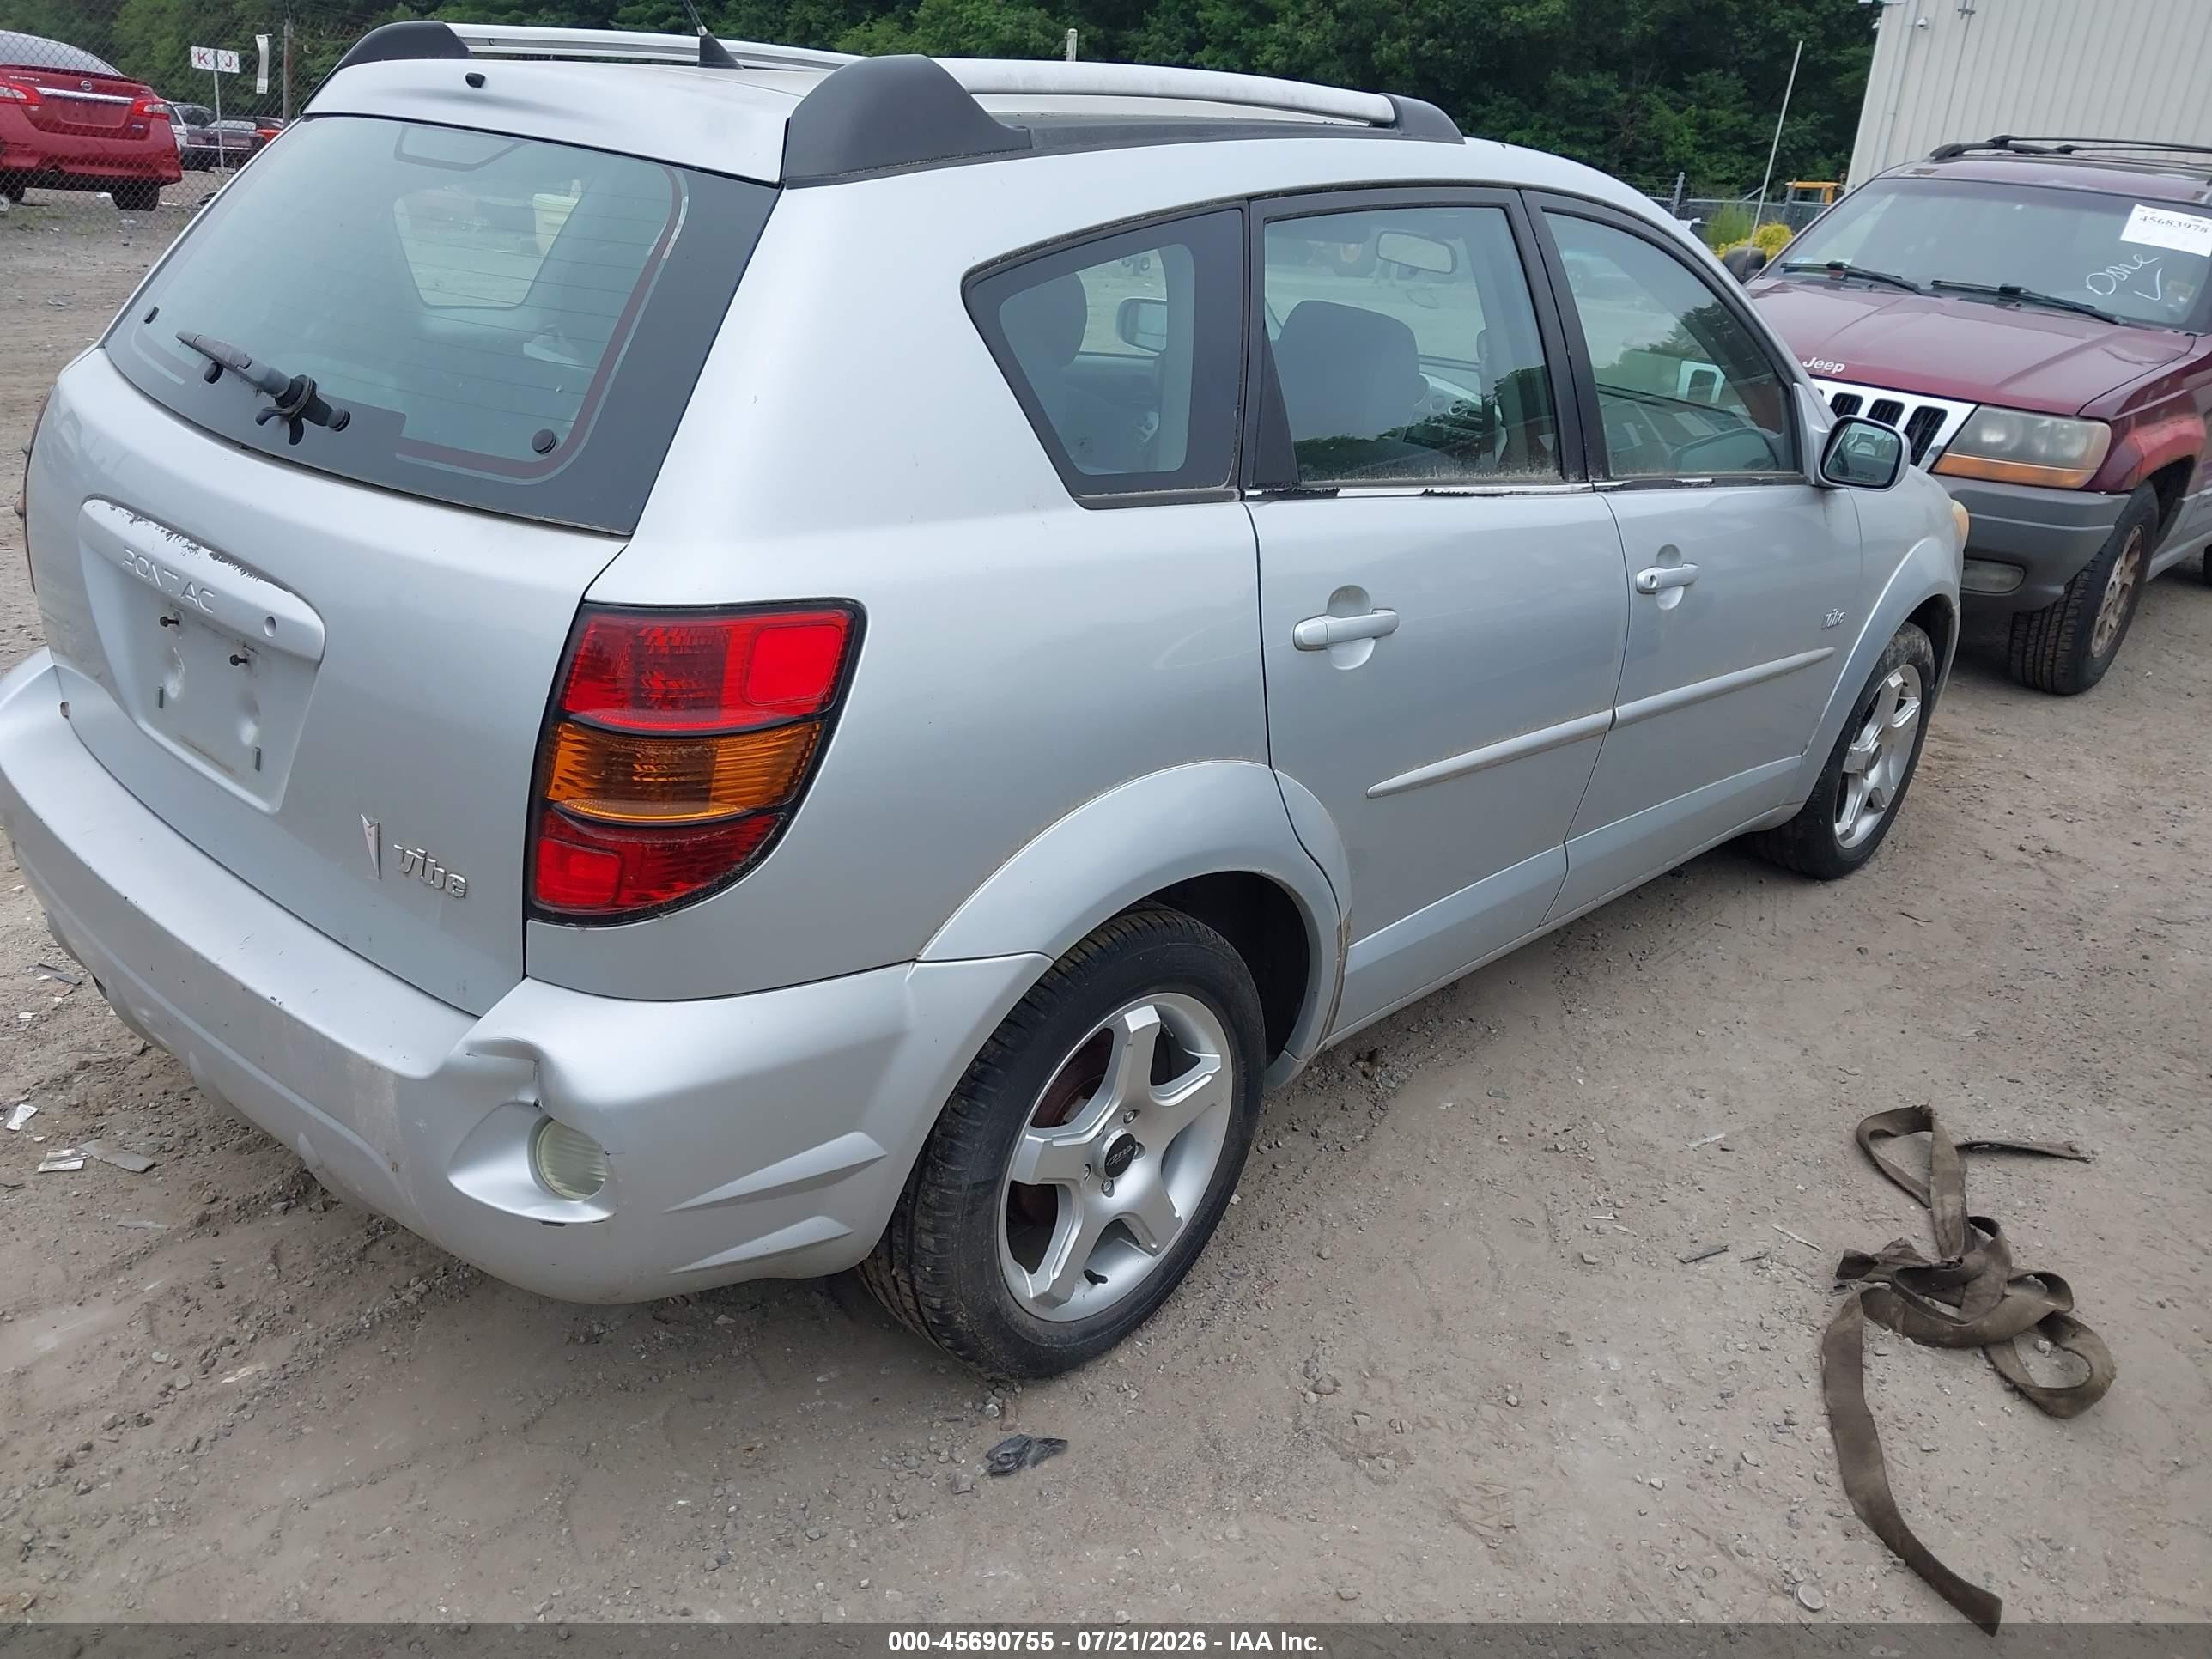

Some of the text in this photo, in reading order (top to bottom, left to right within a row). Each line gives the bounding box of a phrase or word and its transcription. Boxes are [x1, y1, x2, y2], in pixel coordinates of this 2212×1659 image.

[197, 52, 233, 68] K J
[2139, 215, 2209, 234] 45683978
[1802, 356, 1845, 374] Jeep
[122, 545, 216, 613] PONTAC
